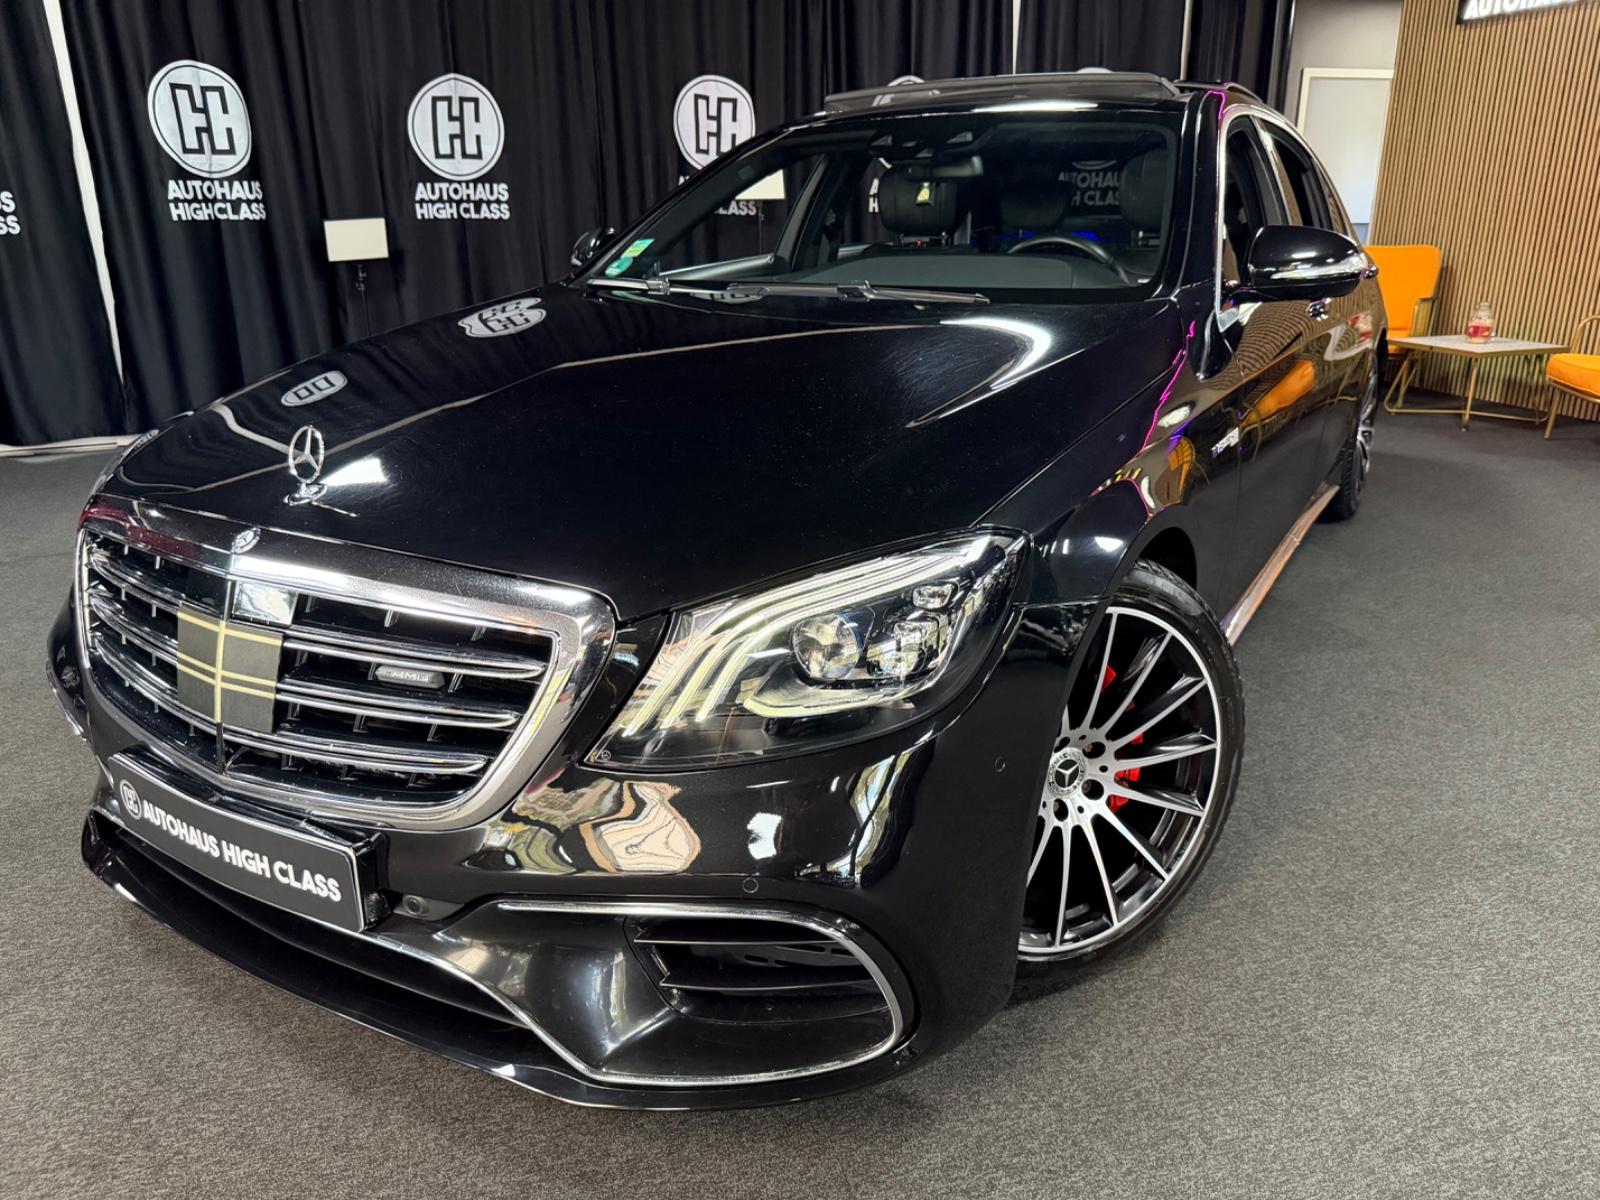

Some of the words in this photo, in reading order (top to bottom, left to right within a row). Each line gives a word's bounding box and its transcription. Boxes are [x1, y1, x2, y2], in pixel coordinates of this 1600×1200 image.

[167, 179, 263, 200] AUTOHAUS
[414, 182, 510, 201] AUTOHAUS
[415, 202, 458, 219] HIGH
[459, 202, 511, 220] CLASS
[143, 799, 220, 858] AUTOHAUS
[221, 839, 271, 878] HIGH
[273, 860, 342, 902] CLASS
